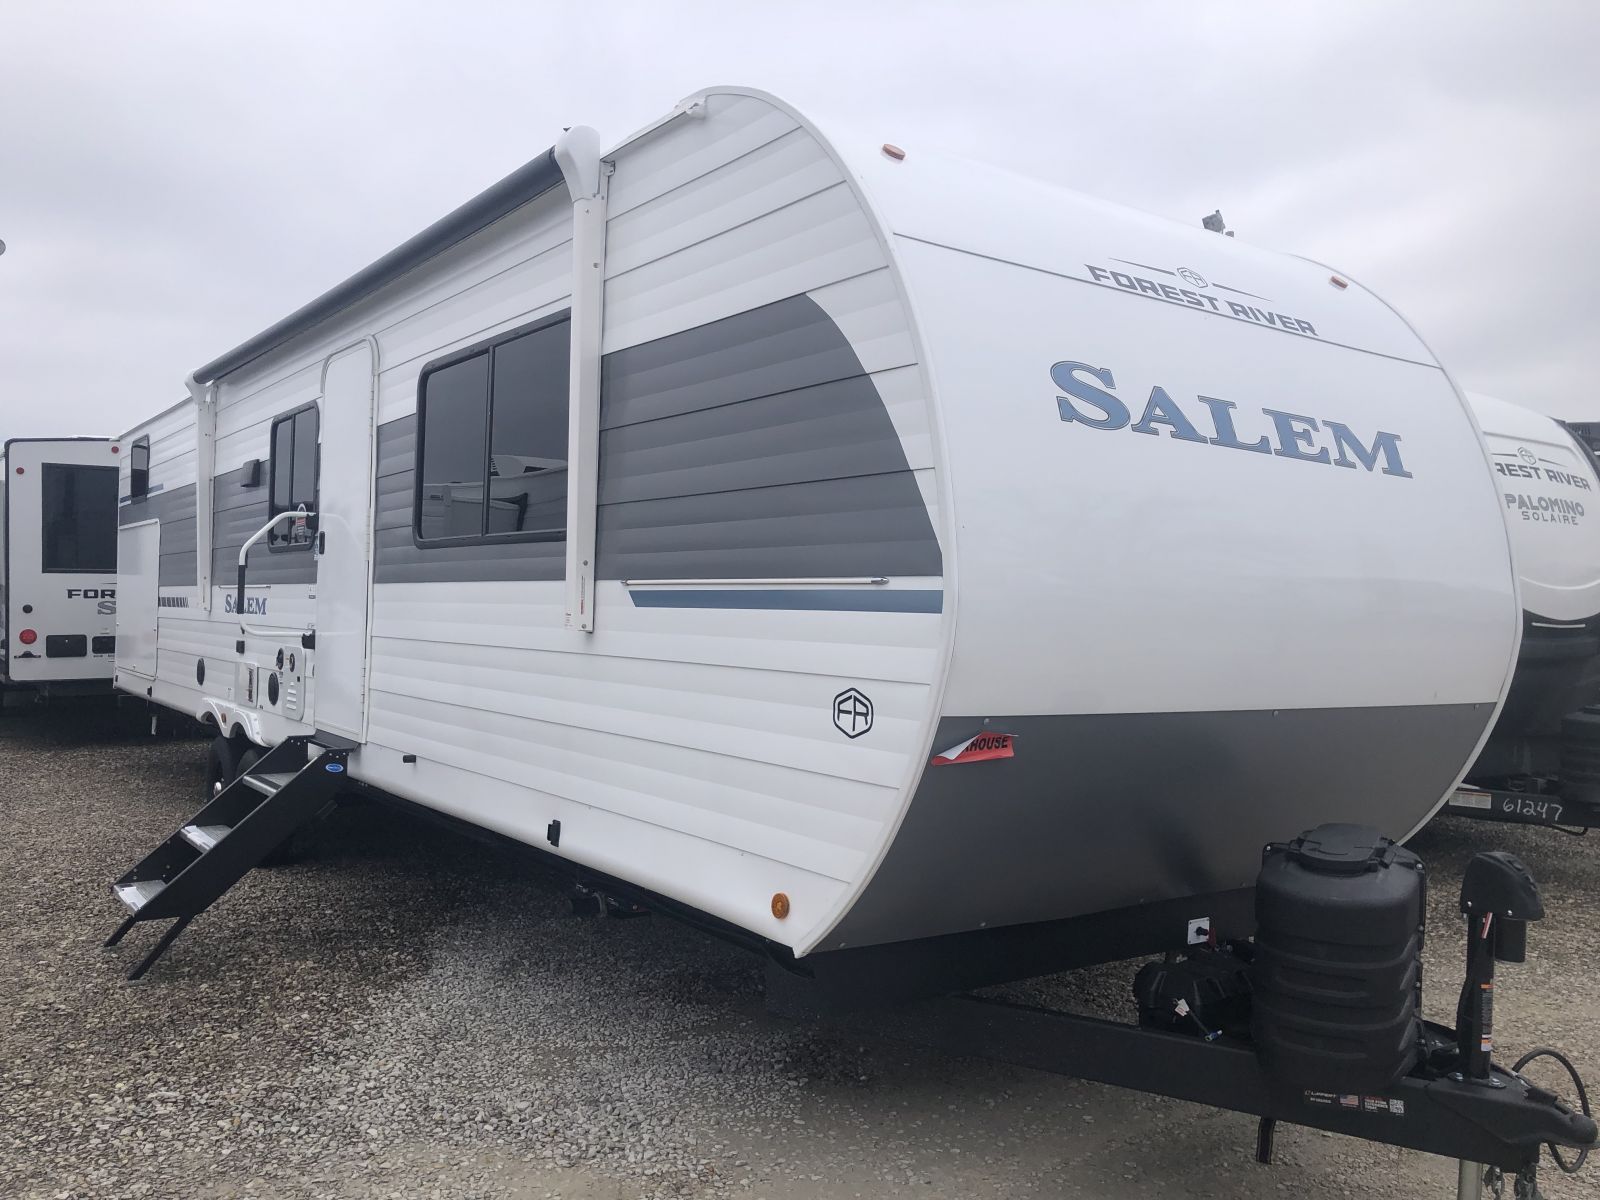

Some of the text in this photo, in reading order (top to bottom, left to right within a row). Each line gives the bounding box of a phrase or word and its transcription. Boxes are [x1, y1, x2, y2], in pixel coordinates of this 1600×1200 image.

[1084, 263, 1319, 337] FOREST RIVER
[1049, 359, 1414, 479] SALEM
[1494, 462, 1592, 492] REST RIVER
[1503, 493, 1585, 517] PALOMINO
[1521, 511, 1579, 526] SOLAIRE
[66, 588, 116, 599] FOR
[224, 593, 268, 616] SAEM
[1502, 797, 1563, 821] 61247
